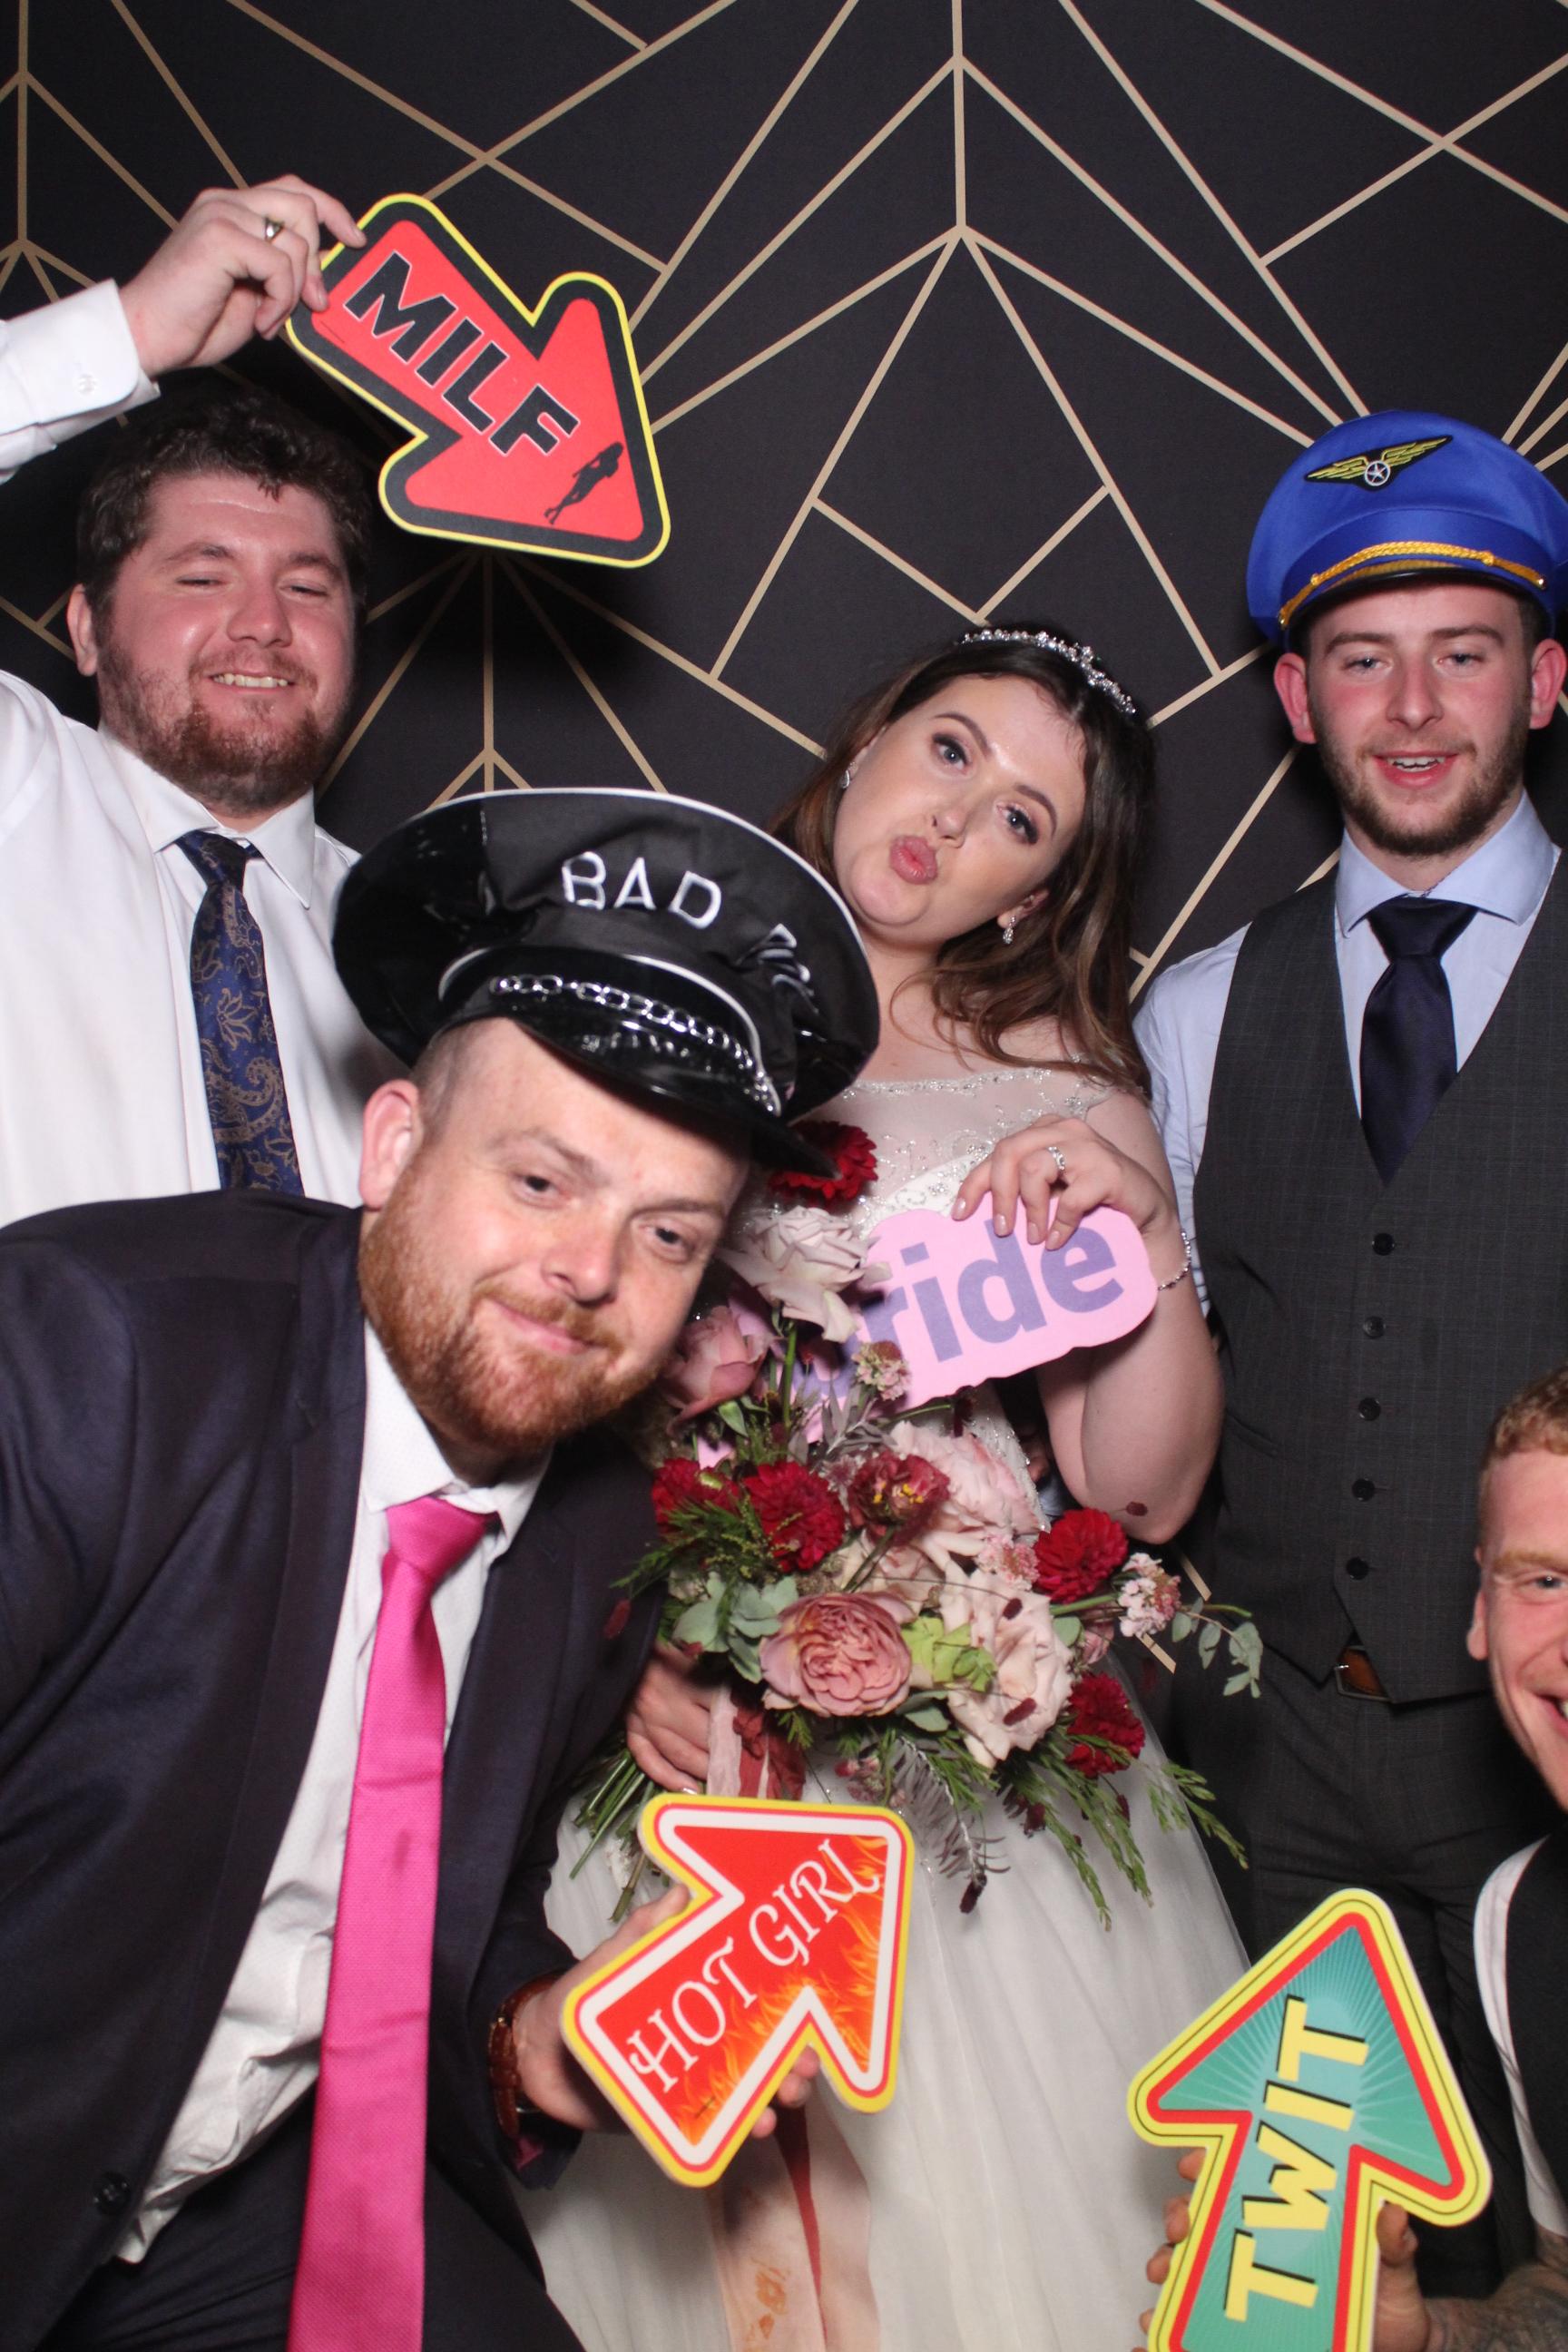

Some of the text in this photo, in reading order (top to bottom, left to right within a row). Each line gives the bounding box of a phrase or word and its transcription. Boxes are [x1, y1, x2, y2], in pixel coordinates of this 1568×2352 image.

[342, 250, 581, 457] MILF
[561, 850, 722, 930] BAD
[791, 1217, 1124, 1403] ride
[626, 1838, 881, 2094] HOT GIRL
[1223, 1994, 1369, 2323] TWIT
